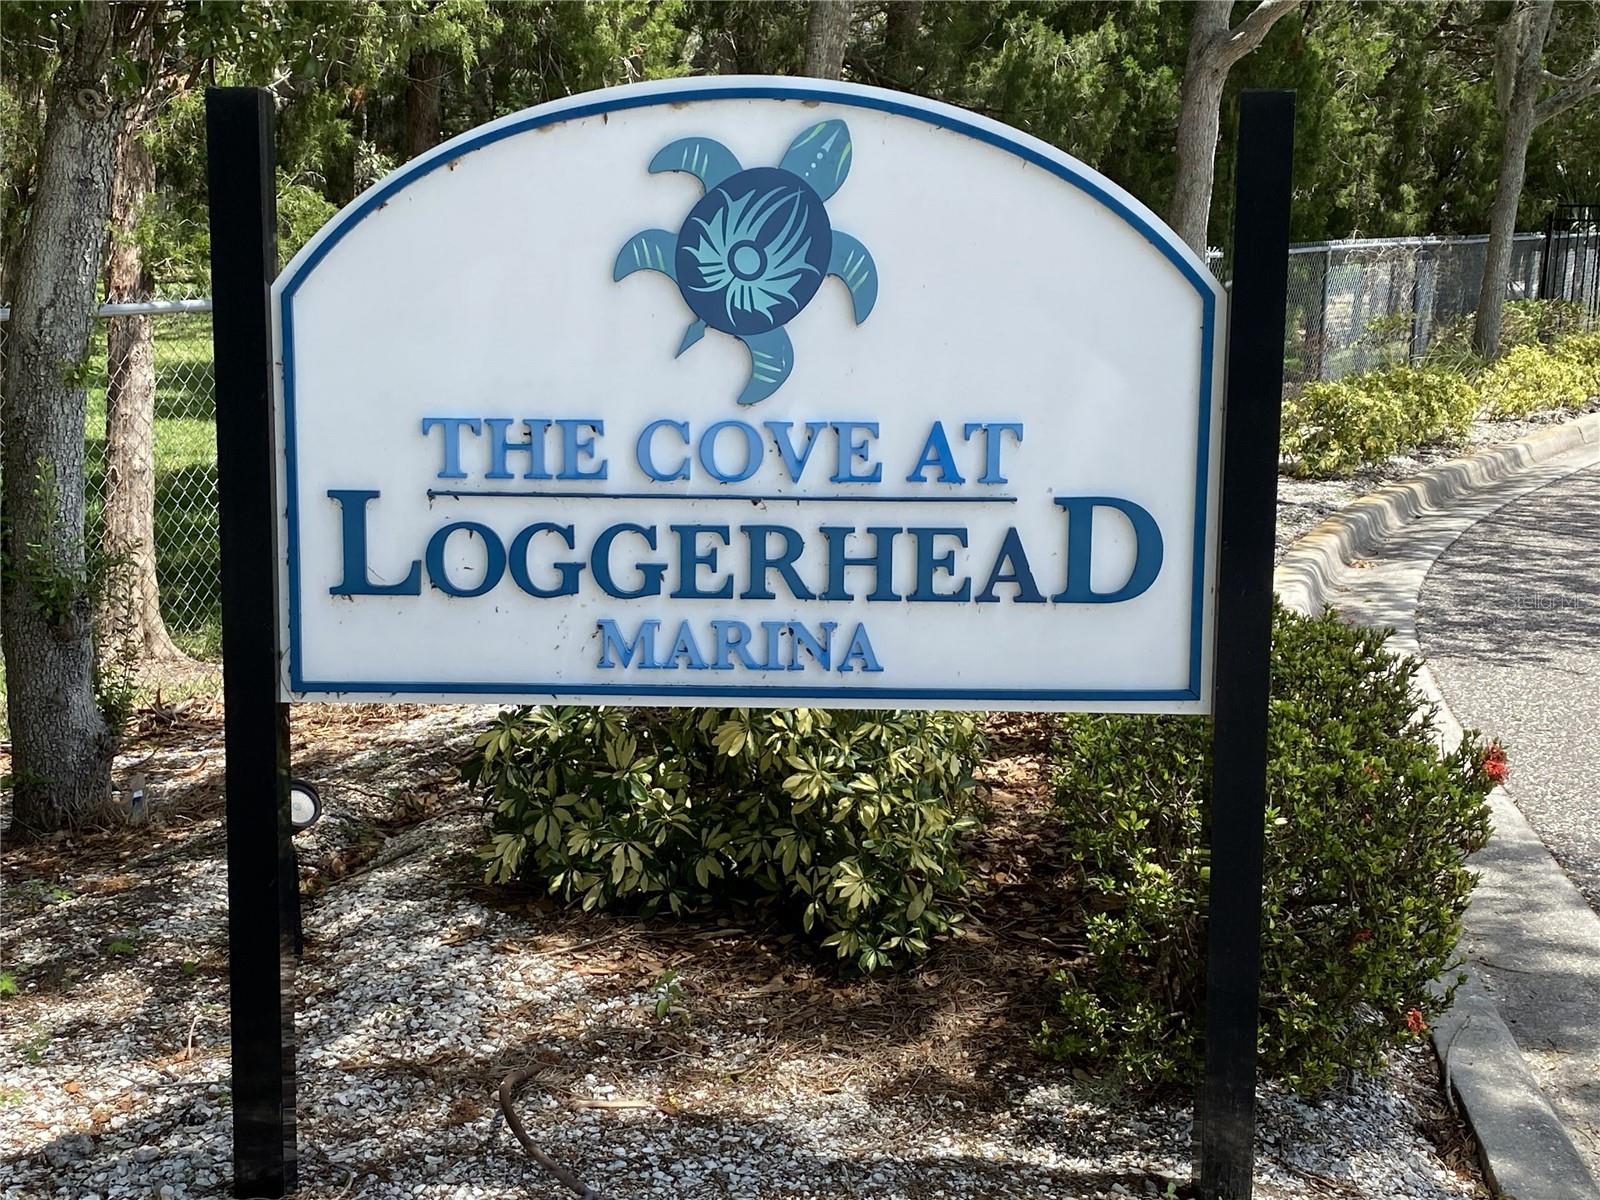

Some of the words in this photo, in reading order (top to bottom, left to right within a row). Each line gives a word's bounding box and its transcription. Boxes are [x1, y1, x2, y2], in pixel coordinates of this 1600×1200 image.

[422, 417, 608, 481] THE
[636, 419, 882, 484] COVE
[906, 421, 1023, 485] AT
[327, 490, 1164, 604] LOGGERHEAD
[597, 619, 884, 673] MARINA
